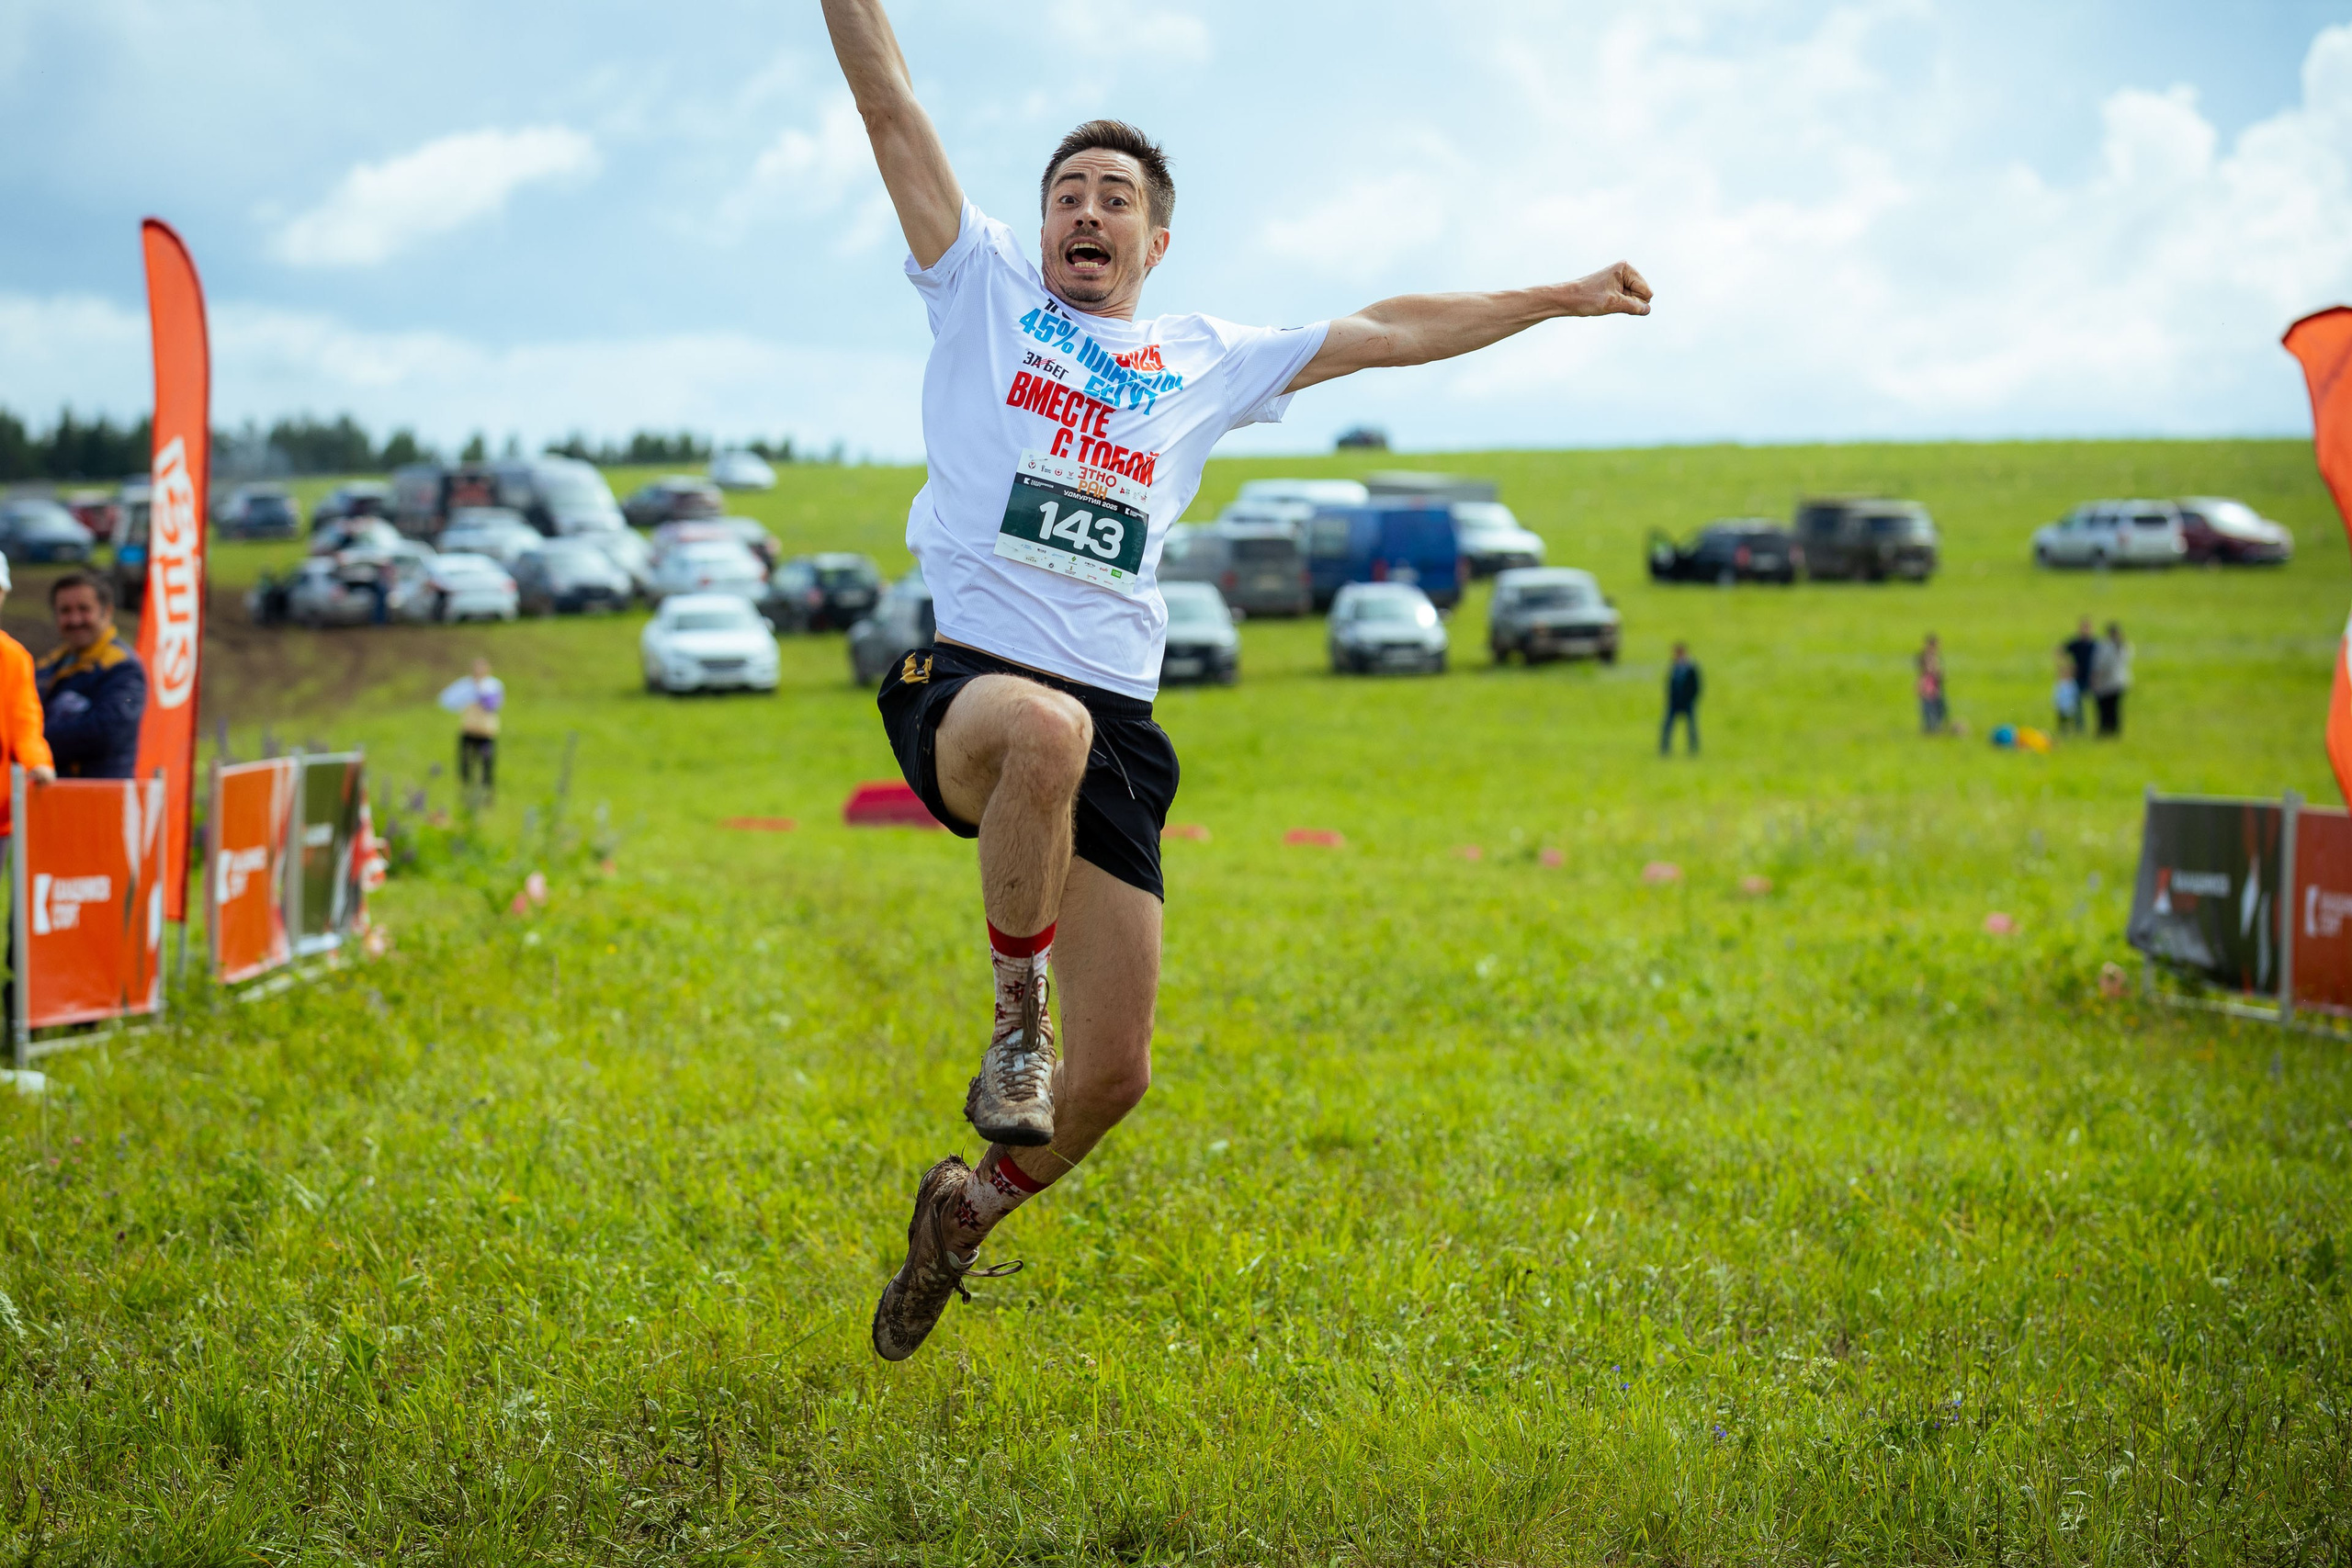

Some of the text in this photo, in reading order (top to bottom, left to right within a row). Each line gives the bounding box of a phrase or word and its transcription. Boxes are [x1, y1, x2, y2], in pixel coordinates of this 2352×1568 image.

[1019, 308, 1080, 354] 45%
[1006, 370, 1116, 438] ВМЕСТЕ
[1050, 427, 1074, 458] С
[1077, 466, 1117, 488] ЭТНО
[1077, 479, 1108, 500] РАН
[1063, 489, 1118, 512] УДМУРТИЯ 2025
[1039, 501, 1125, 559] 143
